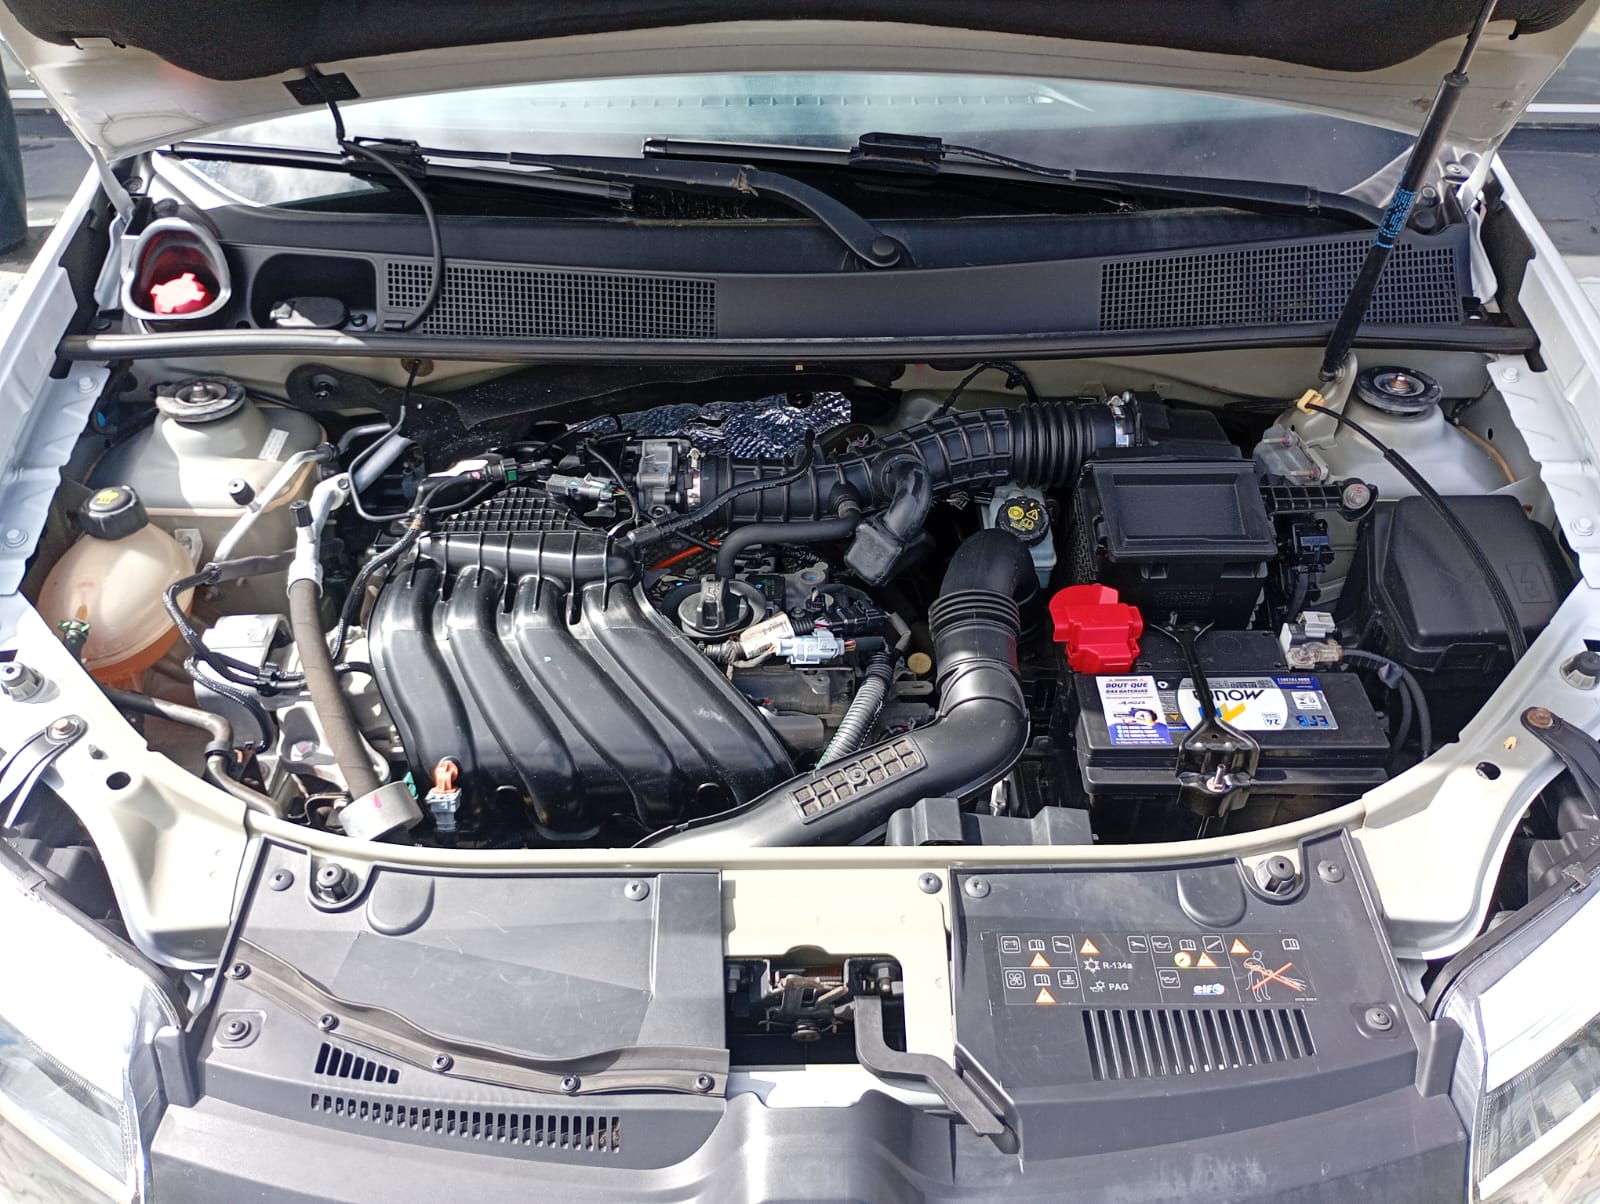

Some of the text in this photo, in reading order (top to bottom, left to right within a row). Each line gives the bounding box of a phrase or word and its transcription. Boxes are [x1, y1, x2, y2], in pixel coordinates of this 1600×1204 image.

[1296, 714, 1329, 728] EFB
[1102, 961, 1133, 970] R-134a
[1108, 982, 1129, 992] PAG
